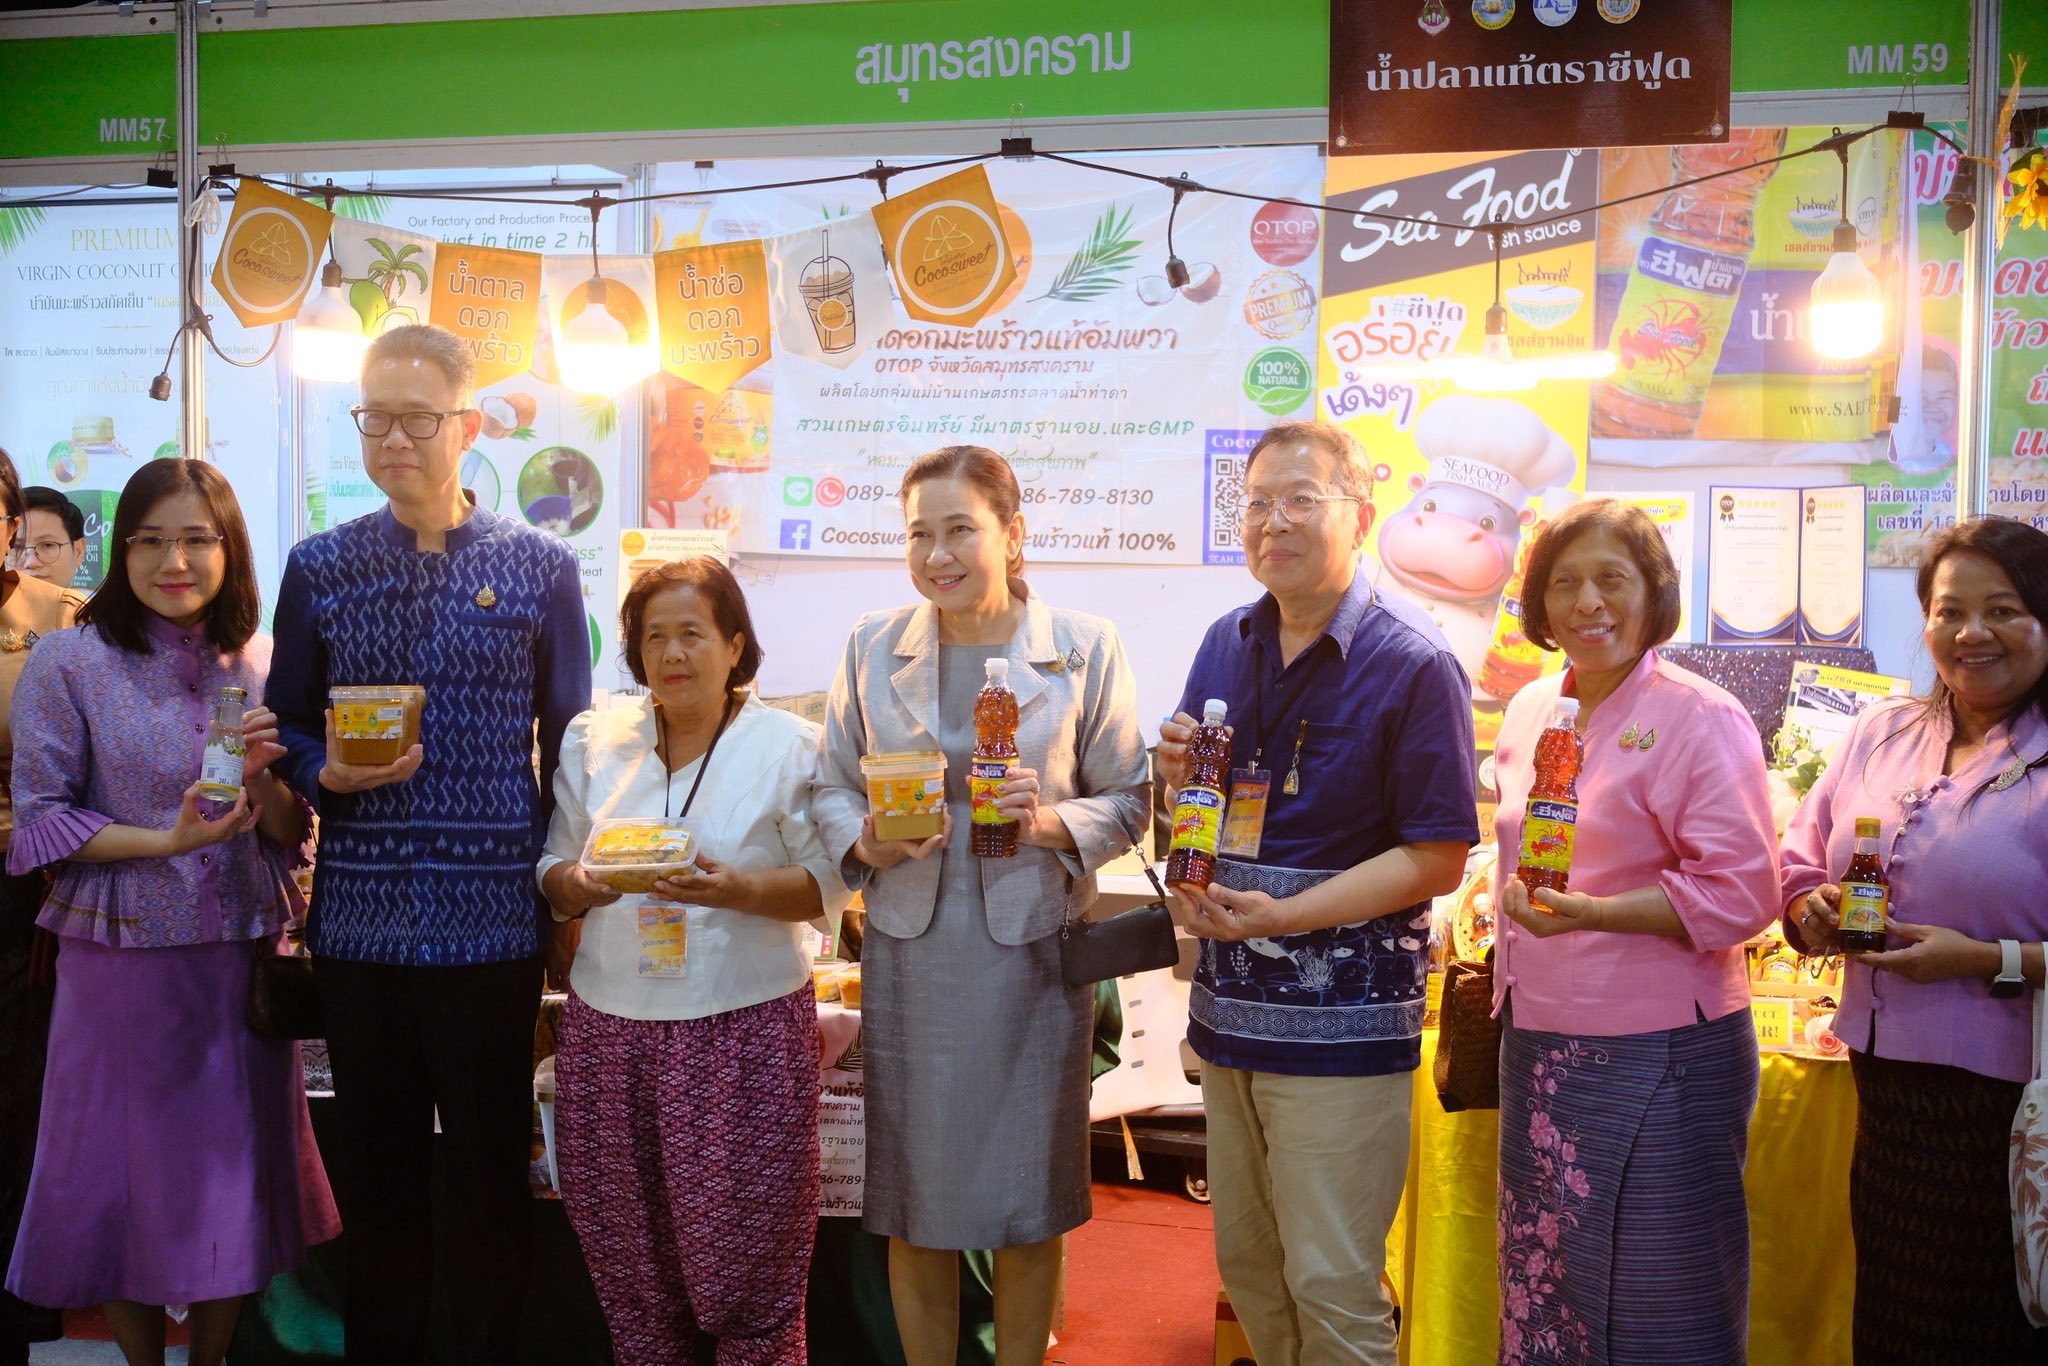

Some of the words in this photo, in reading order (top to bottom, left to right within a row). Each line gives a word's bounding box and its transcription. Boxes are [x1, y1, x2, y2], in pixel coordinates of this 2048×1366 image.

[855, 29, 1132, 103] สมุทรสงคราม
[1366, 50, 1691, 91] น้ำปลาแท้ตราซีฟูด
[100, 118, 167, 142] MM57
[1340, 188, 1441, 263] Sea
[1446, 151, 1576, 248] Food
[408, 216, 430, 228] Our
[432, 214, 472, 229] Factory
[475, 214, 496, 226] and
[499, 213, 555, 226] Production
[559, 212, 601, 225] Proce
[1253, 220, 1317, 235] OTOP
[481, 232, 497, 248] in
[506, 231, 547, 249] time
[555, 232, 568, 249] 2
[1487, 229, 1521, 251] Fsh
[1524, 218, 1582, 244] sauce
[17, 264, 72, 281] VIRGIN
[77, 262, 165, 280] COCONUT
[233, 247, 304, 285] Cocosweet
[913, 242, 996, 287] Cocosweet
[1649, 248, 1734, 290] ซีฟูด
[449, 259, 526, 300] น้ำตาล
[680, 264, 744, 299] น้ำช่อ
[1249, 288, 1312, 320] PREMIUM
[458, 305, 510, 330] ดอก
[688, 307, 741, 331] ดอก
[876, 318, 1179, 350] ดอกมะพร้าวแท้อัมพวา
[464, 332, 524, 363] พร้าว
[670, 331, 761, 365] มะพร้าว
[875, 357, 923, 374] OTOP
[928, 355, 1095, 381] จังหวัดสมุทรสงคราม
[1256, 360, 1300, 377] 100%
[1258, 375, 1300, 386] NATURAL
[796, 413, 966, 435] สวนเกษตรอินทรีย์
[1441, 456, 1510, 486] SEAFOOD
[1021, 487, 1154, 505] 86-789-8130
[1877, 504, 1923, 530] เลขที่
[821, 526, 906, 546] Cocoswe
[1023, 526, 1113, 550] ะพร้าวแท้
[1119, 532, 1176, 551] 100%
[1208, 555, 1237, 564] SCAN
